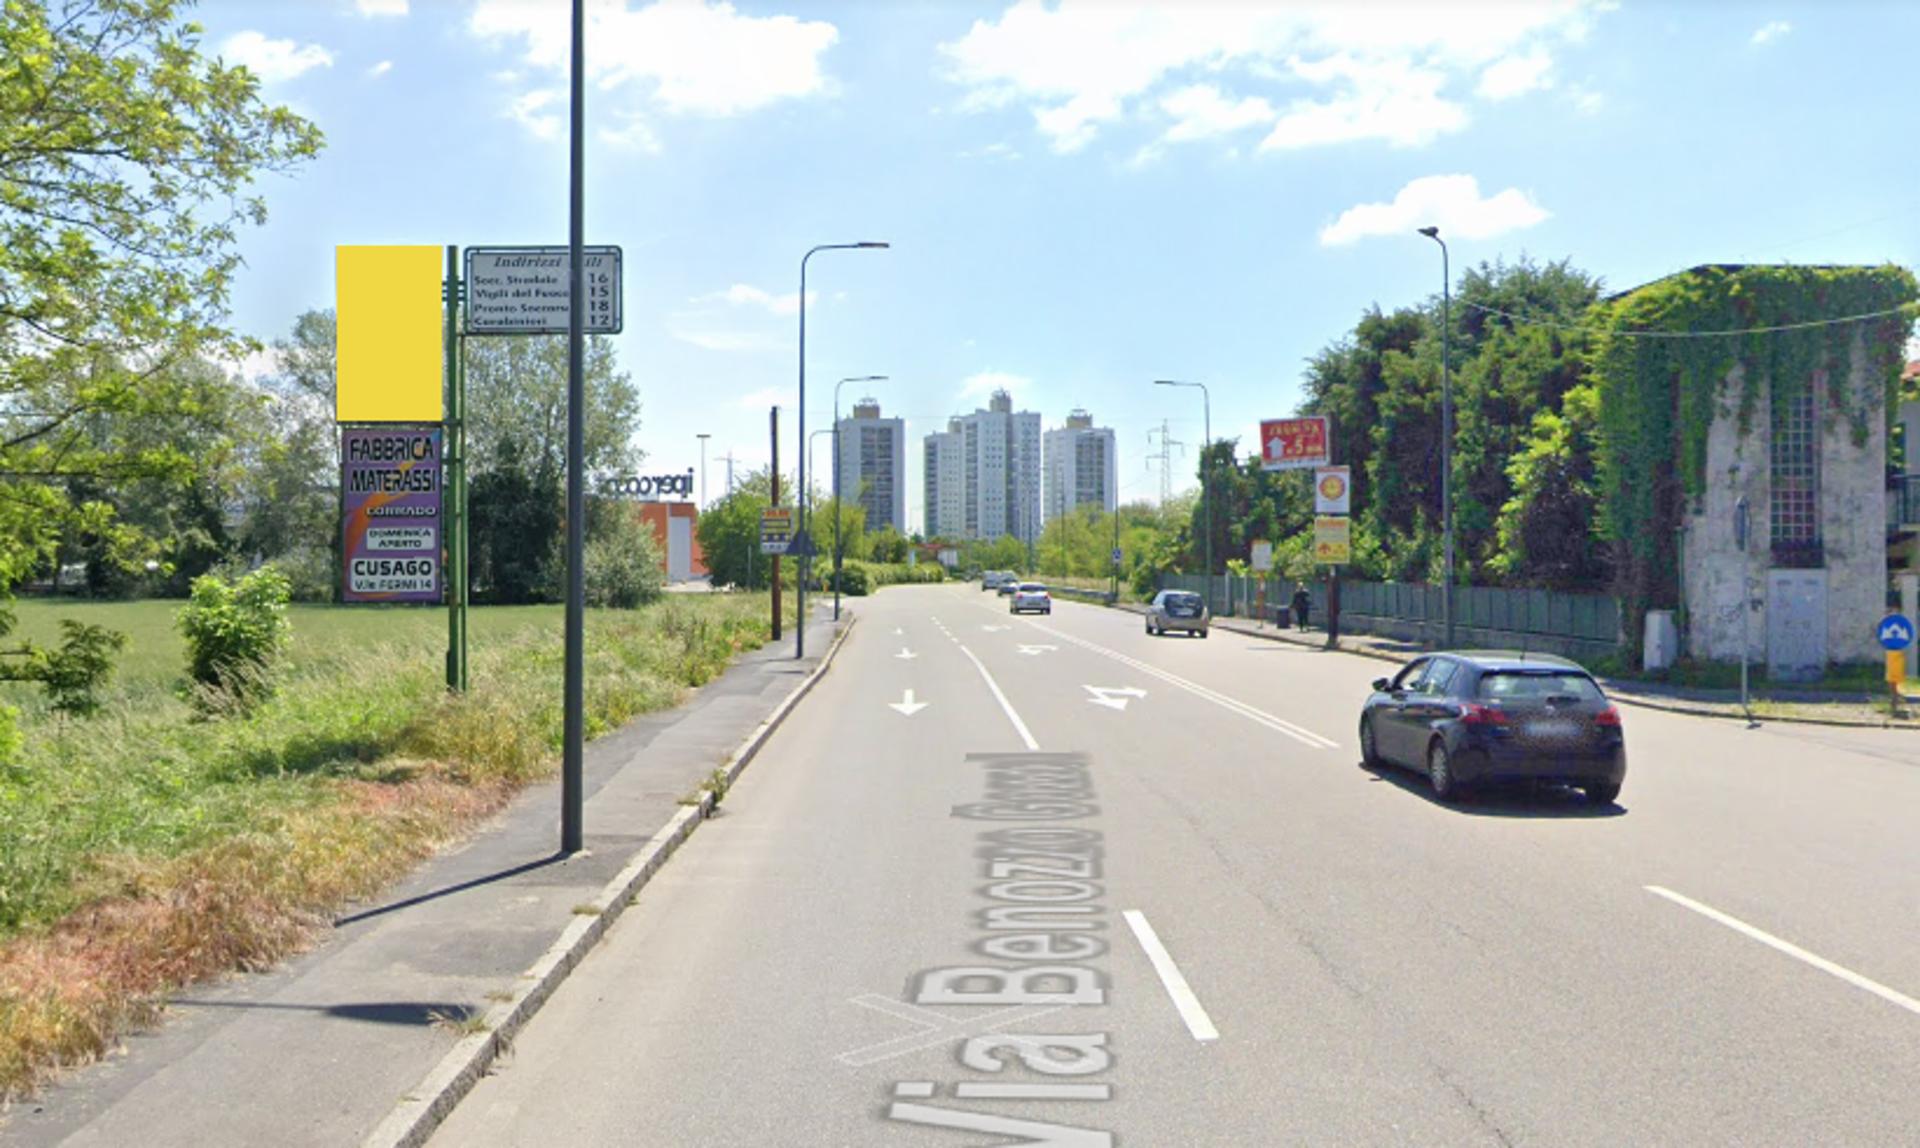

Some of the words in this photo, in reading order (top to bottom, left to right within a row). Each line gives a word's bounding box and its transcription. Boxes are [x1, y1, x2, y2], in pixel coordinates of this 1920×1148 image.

[493, 256, 562, 268] Indirizzi
[589, 273, 609, 284] 16
[475, 289, 508, 301] Vigili
[589, 285, 609, 297] 15
[474, 304, 517, 313] Pronto
[589, 300, 609, 312] 18
[589, 315, 609, 326] 12
[350, 437, 434, 462] FABBRICA
[350, 469, 437, 492] MATERASSI
[369, 528, 431, 538] DOMENICA
[378, 539, 422, 548] APERTO
[354, 560, 432, 577] CUSAGO
